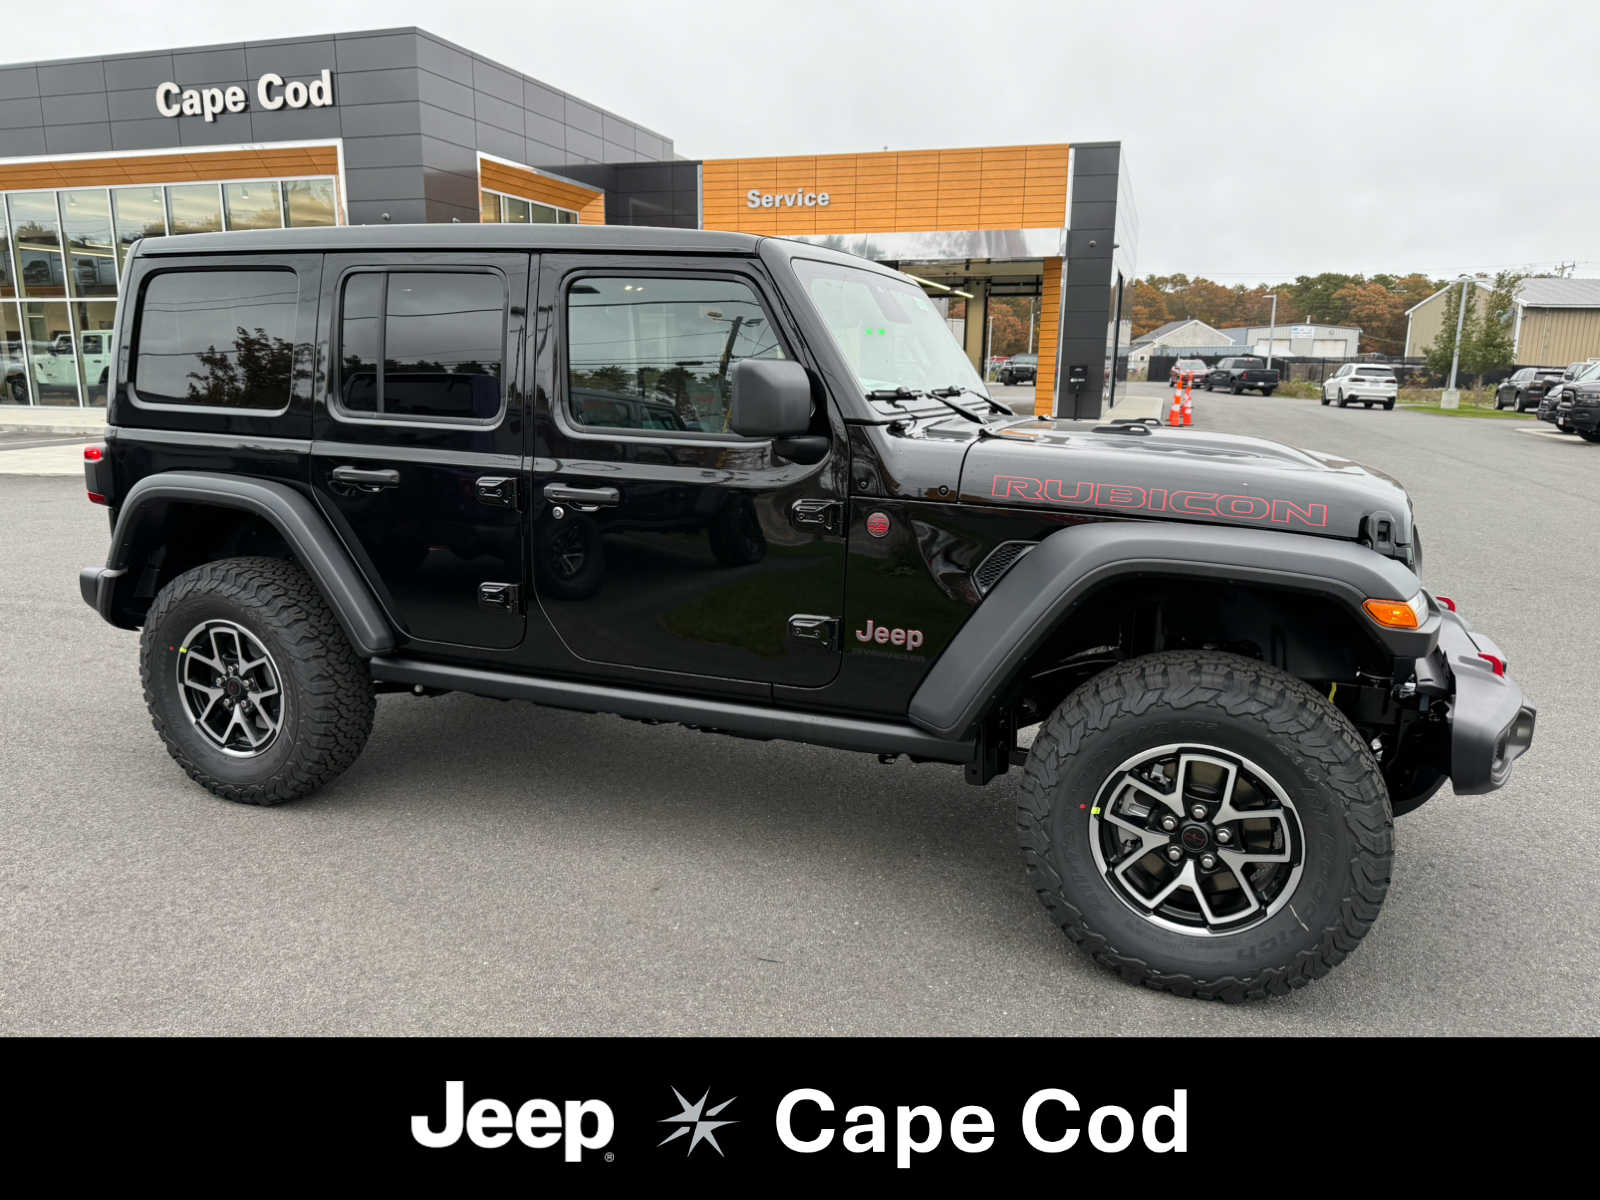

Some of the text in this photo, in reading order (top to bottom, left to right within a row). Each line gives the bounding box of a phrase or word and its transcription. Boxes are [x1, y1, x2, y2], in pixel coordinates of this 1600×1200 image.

[155, 68, 334, 123] Cape Cod
[746, 187, 831, 209] Service
[991, 474, 1328, 529] RUBICON
[855, 619, 924, 651] Jeep
